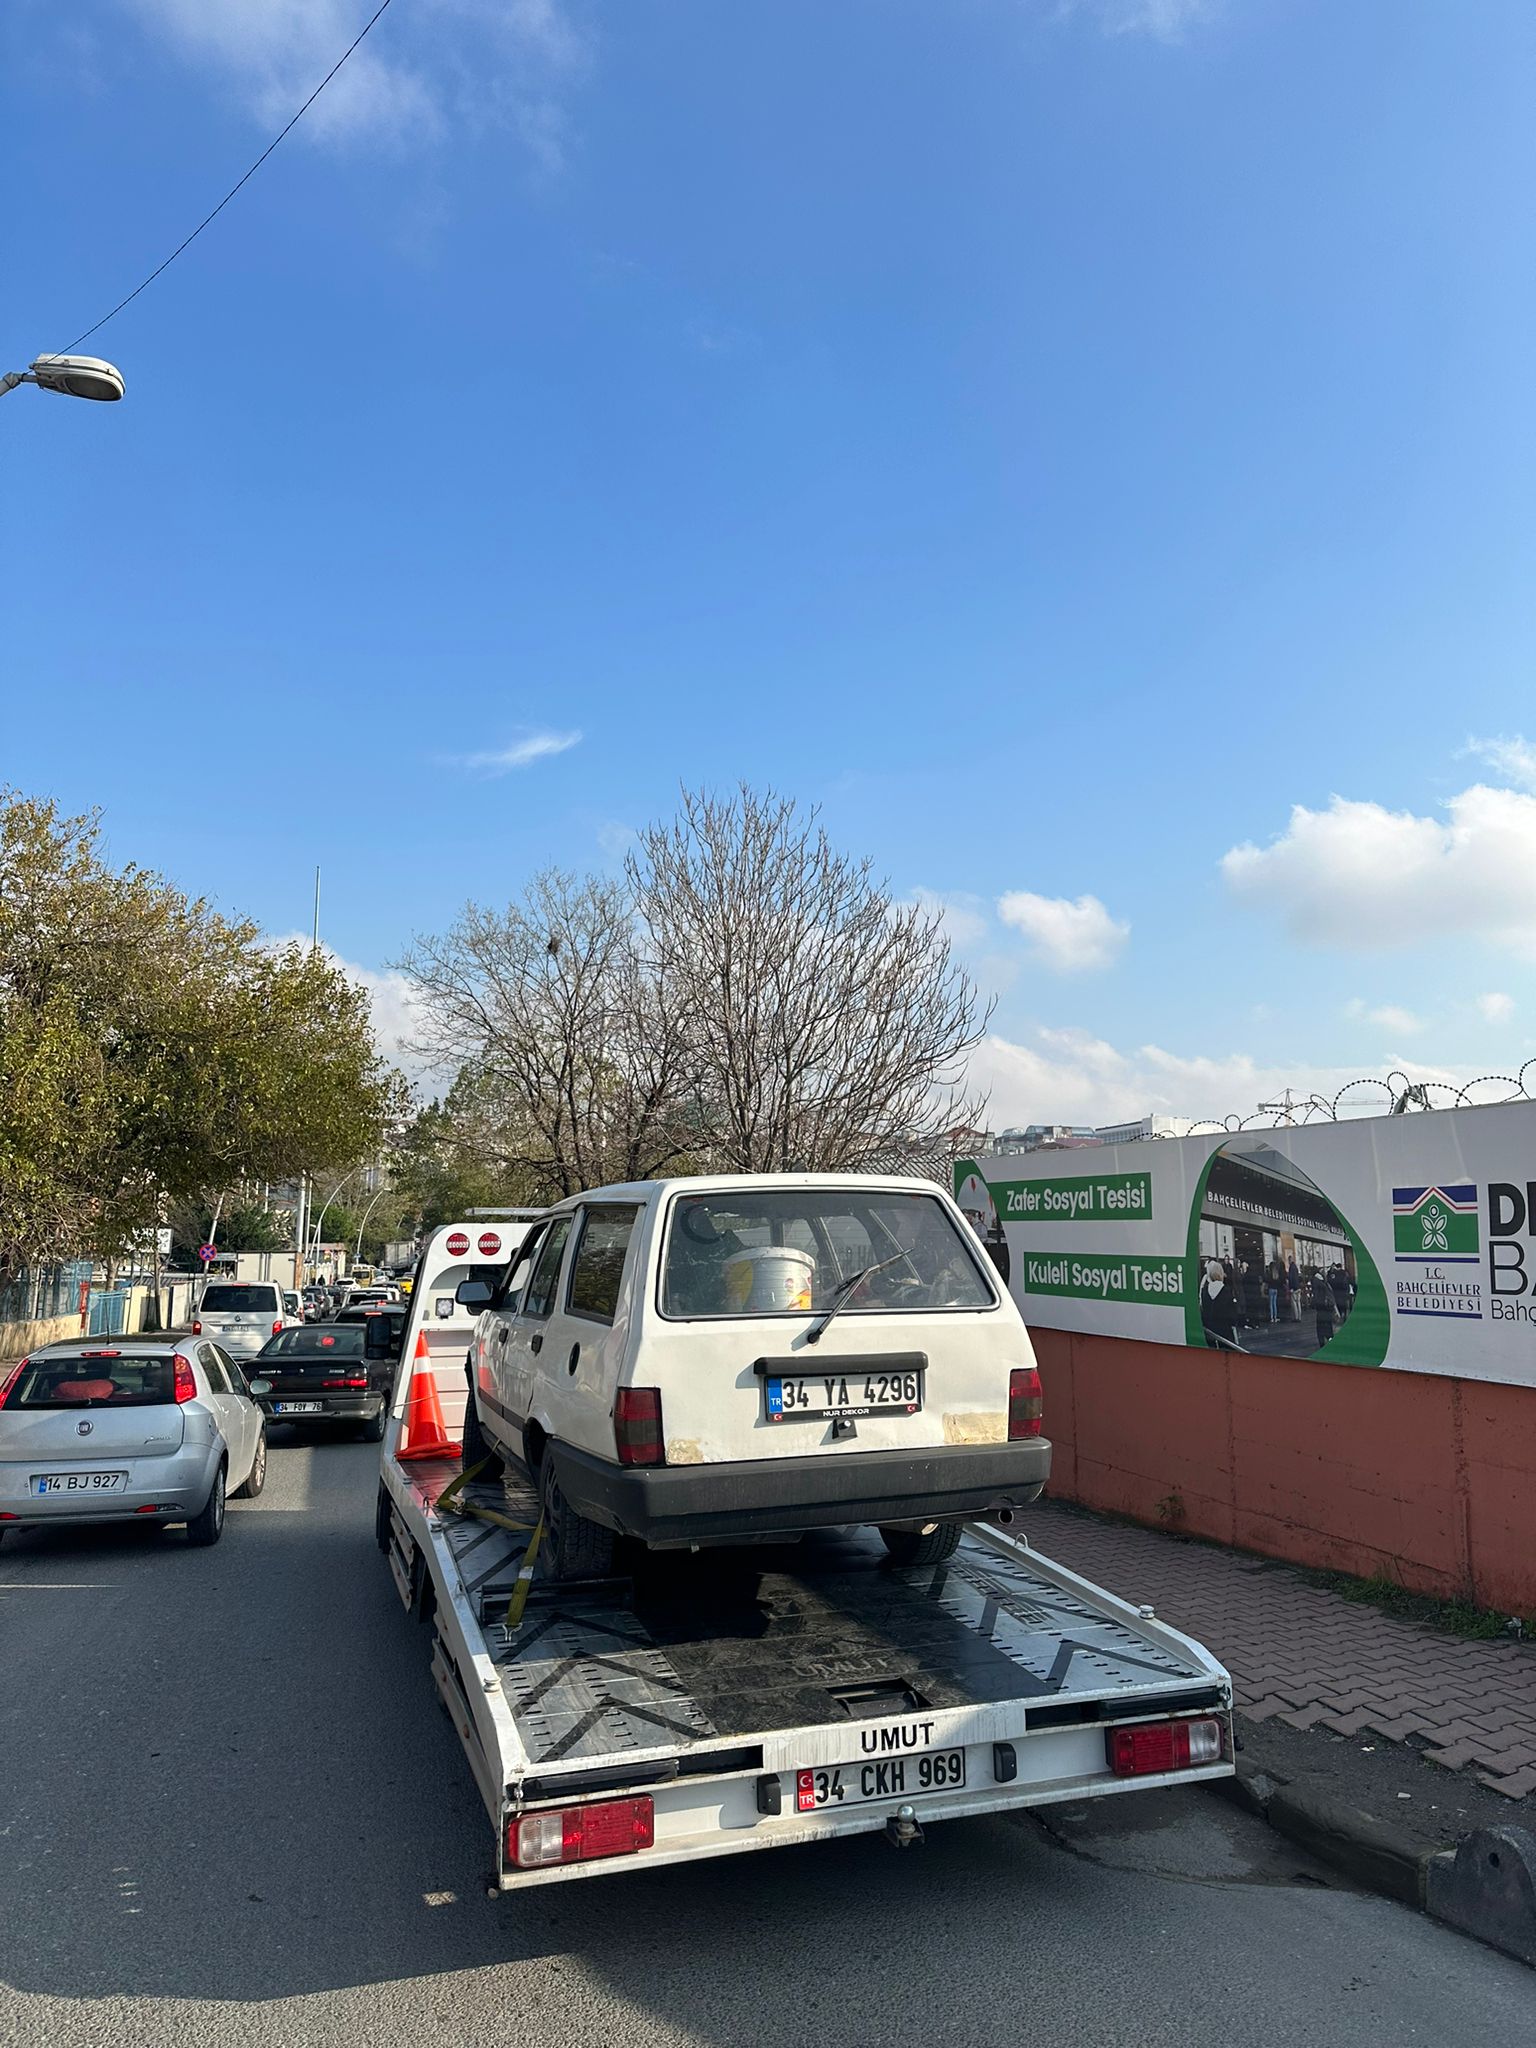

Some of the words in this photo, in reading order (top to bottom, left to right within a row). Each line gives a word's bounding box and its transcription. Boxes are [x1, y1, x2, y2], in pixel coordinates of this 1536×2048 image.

[1006, 1188, 1041, 1212] Zafer
[1043, 1185, 1093, 1218] Sosyal
[1097, 1180, 1146, 1209] Tesisi
[1207, 1191, 1263, 1215] BAHÇELİEVLER
[1028, 1260, 1069, 1285] Kuleli
[1072, 1261, 1127, 1297] Sosyal
[1130, 1264, 1184, 1294] Tesisi
[1425, 1267, 1446, 1279] T.C.
[1488, 1241, 1536, 1297] B
[1396, 1281, 1481, 1295] BAHÇELİEVLER
[1397, 1297, 1481, 1311] BELEDİYESİ
[783, 1381, 809, 1409] 34
[824, 1378, 849, 1406] YA
[864, 1374, 916, 1404] 4296
[842, 1408, 870, 1416] DEKOR
[47, 1477, 61, 1491] 14
[67, 1476, 89, 1490] BJ
[93, 1475, 119, 1488] 927
[861, 1722, 935, 1753] UMUT
[800, 1794, 813, 1805] TR
[815, 1769, 845, 1803] 34
[861, 1761, 905, 1796] CKH
[918, 1753, 961, 1787] 969
